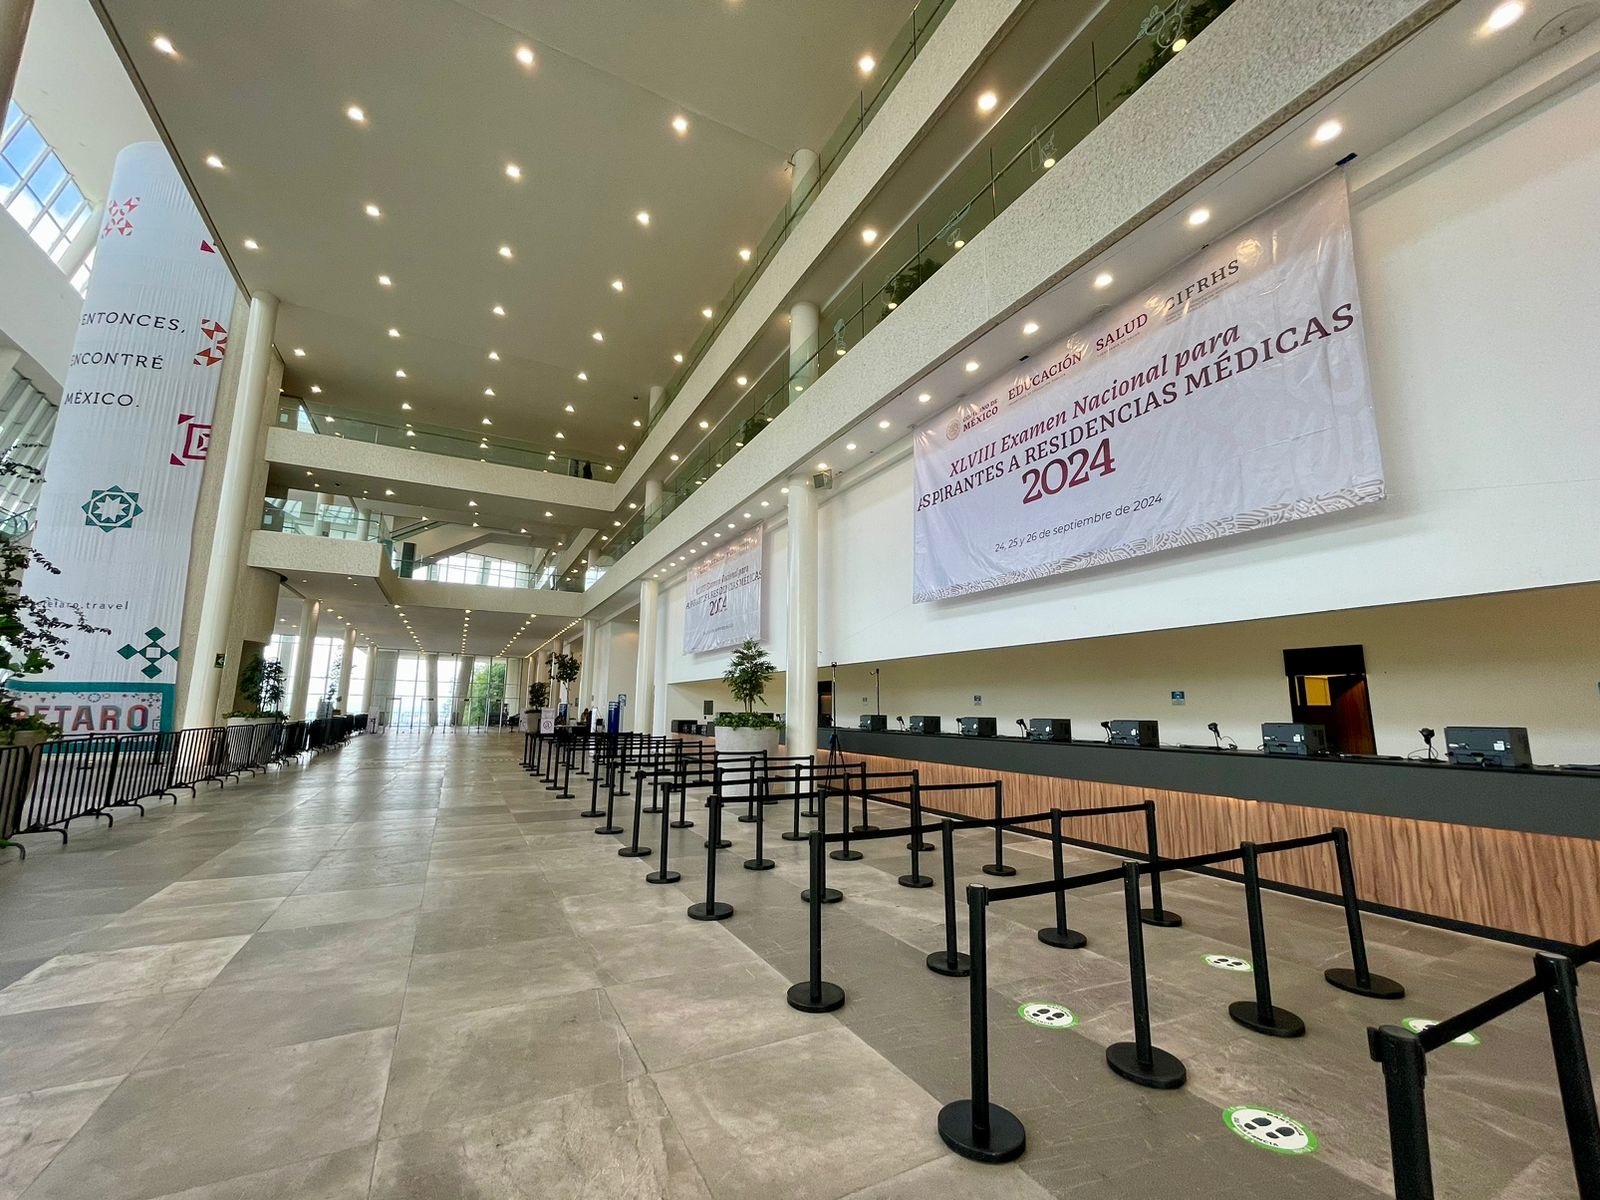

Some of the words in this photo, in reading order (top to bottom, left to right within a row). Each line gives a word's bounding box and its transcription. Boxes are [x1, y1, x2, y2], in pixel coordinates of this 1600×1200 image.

[1164, 259, 1239, 310] CIFRHS
[81, 312, 186, 333] ENTONCES,
[1096, 313, 1148, 351] SALUD
[70, 352, 164, 370] ENCONTRÉ
[1008, 352, 1082, 400] EDUCACIÓN
[64, 390, 140, 408] MÉXICO.
[949, 441, 996, 477] XLVIII
[1000, 410, 1067, 453] Examen
[1072, 354, 1168, 419] Nacional
[1174, 325, 1240, 377] para
[1008, 455, 1021, 473] A
[1025, 382, 1178, 465] RESIDENCIAS
[1184, 303, 1354, 396] MÉDICAS
[963, 406, 998, 432] MÉXICO
[1022, 438, 1117, 505] 2024
[1008, 538, 1018, 549] 25
[1019, 537, 1025, 548] y
[1026, 532, 1037, 543] 26
[1039, 529, 1051, 539] de
[1052, 513, 1112, 535] septiembre
[1115, 504, 1131, 517] de
[1133, 493, 1163, 512] 2024
